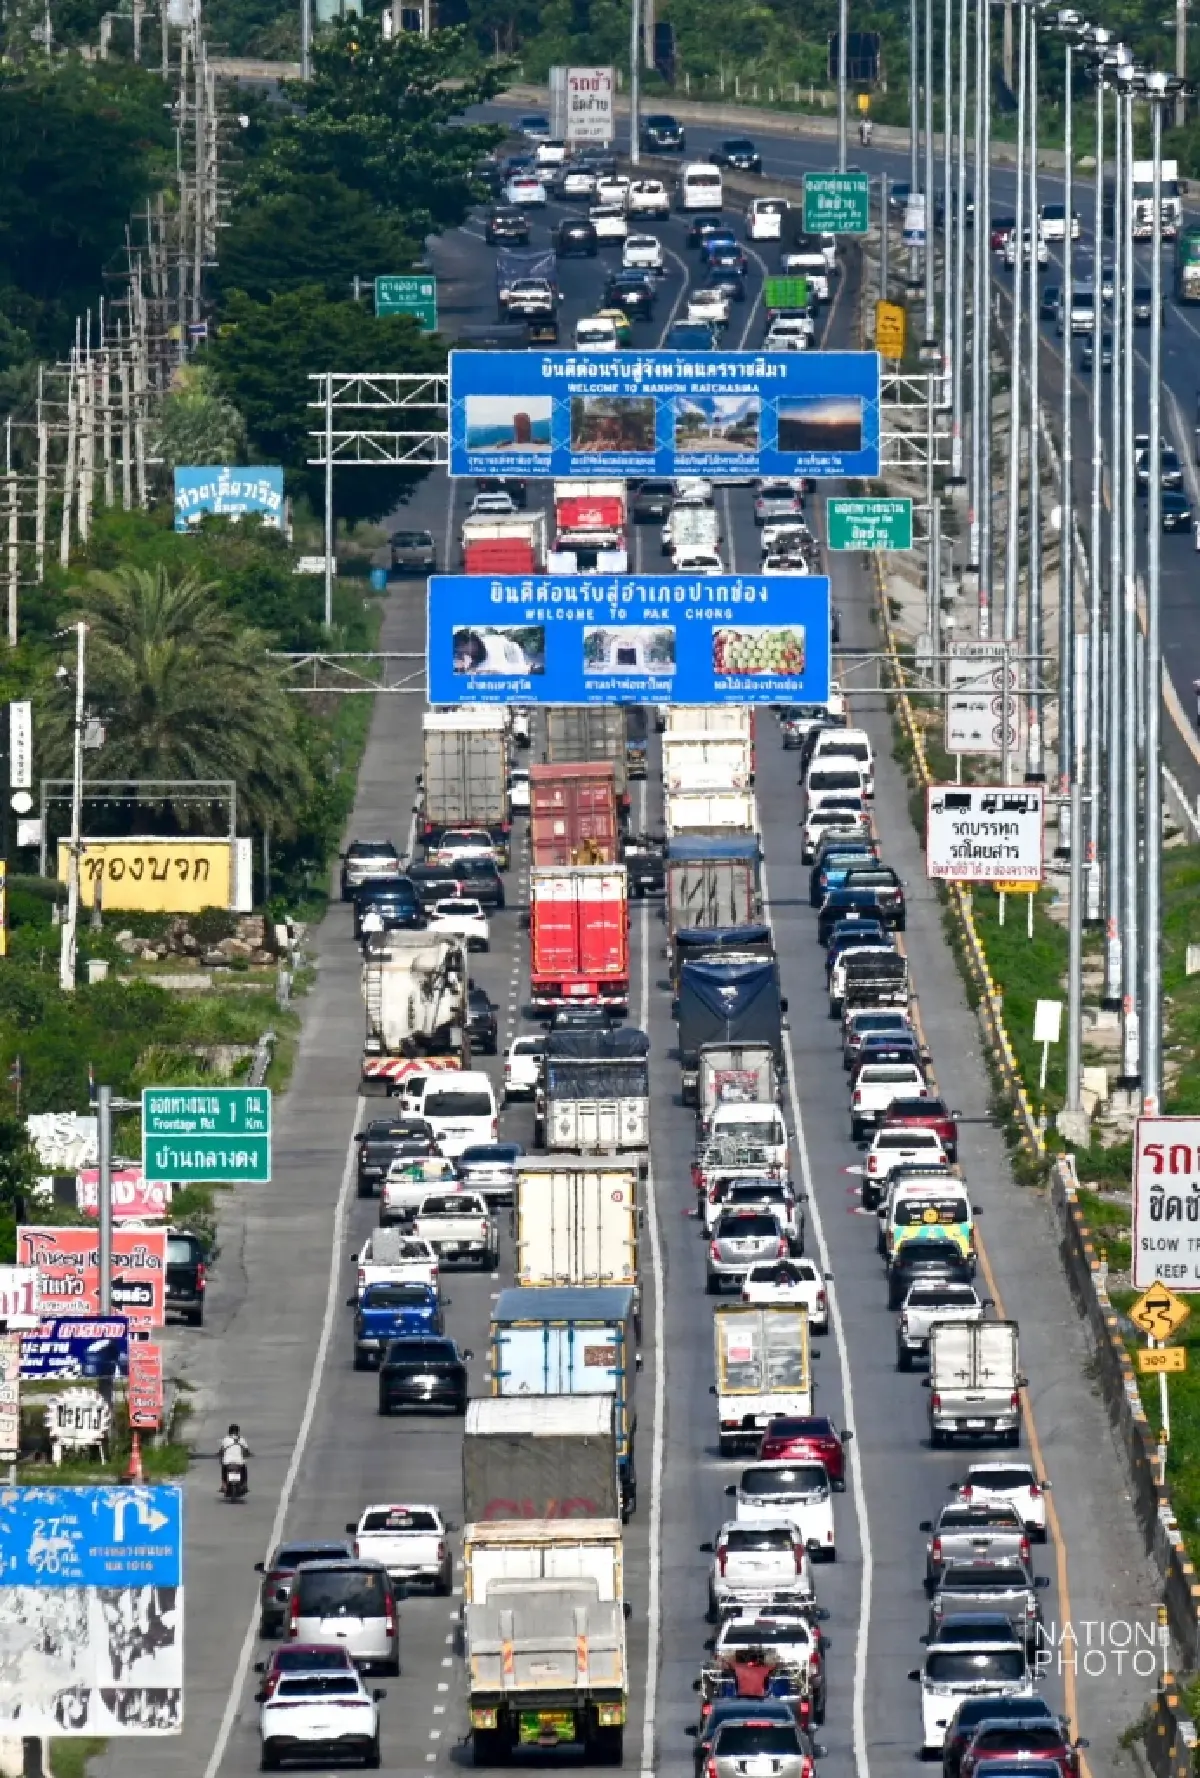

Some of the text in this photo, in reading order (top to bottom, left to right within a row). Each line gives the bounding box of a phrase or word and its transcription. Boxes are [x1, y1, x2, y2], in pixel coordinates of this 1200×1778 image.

[567, 383, 619, 393] WELCOME
[623, 383, 638, 393] TO
[525, 608, 734, 620] WELCOME TO PAK CHONG
[951, 821, 1020, 841] รถบรรทุก
[949, 838, 1020, 859] รถโดยสาร
[229, 1101, 237, 1123] 1
[155, 1144, 259, 1169] บ้านกลางดง
[1141, 1237, 1180, 1251] SLOW
[1154, 1264, 1187, 1279] KEEP
